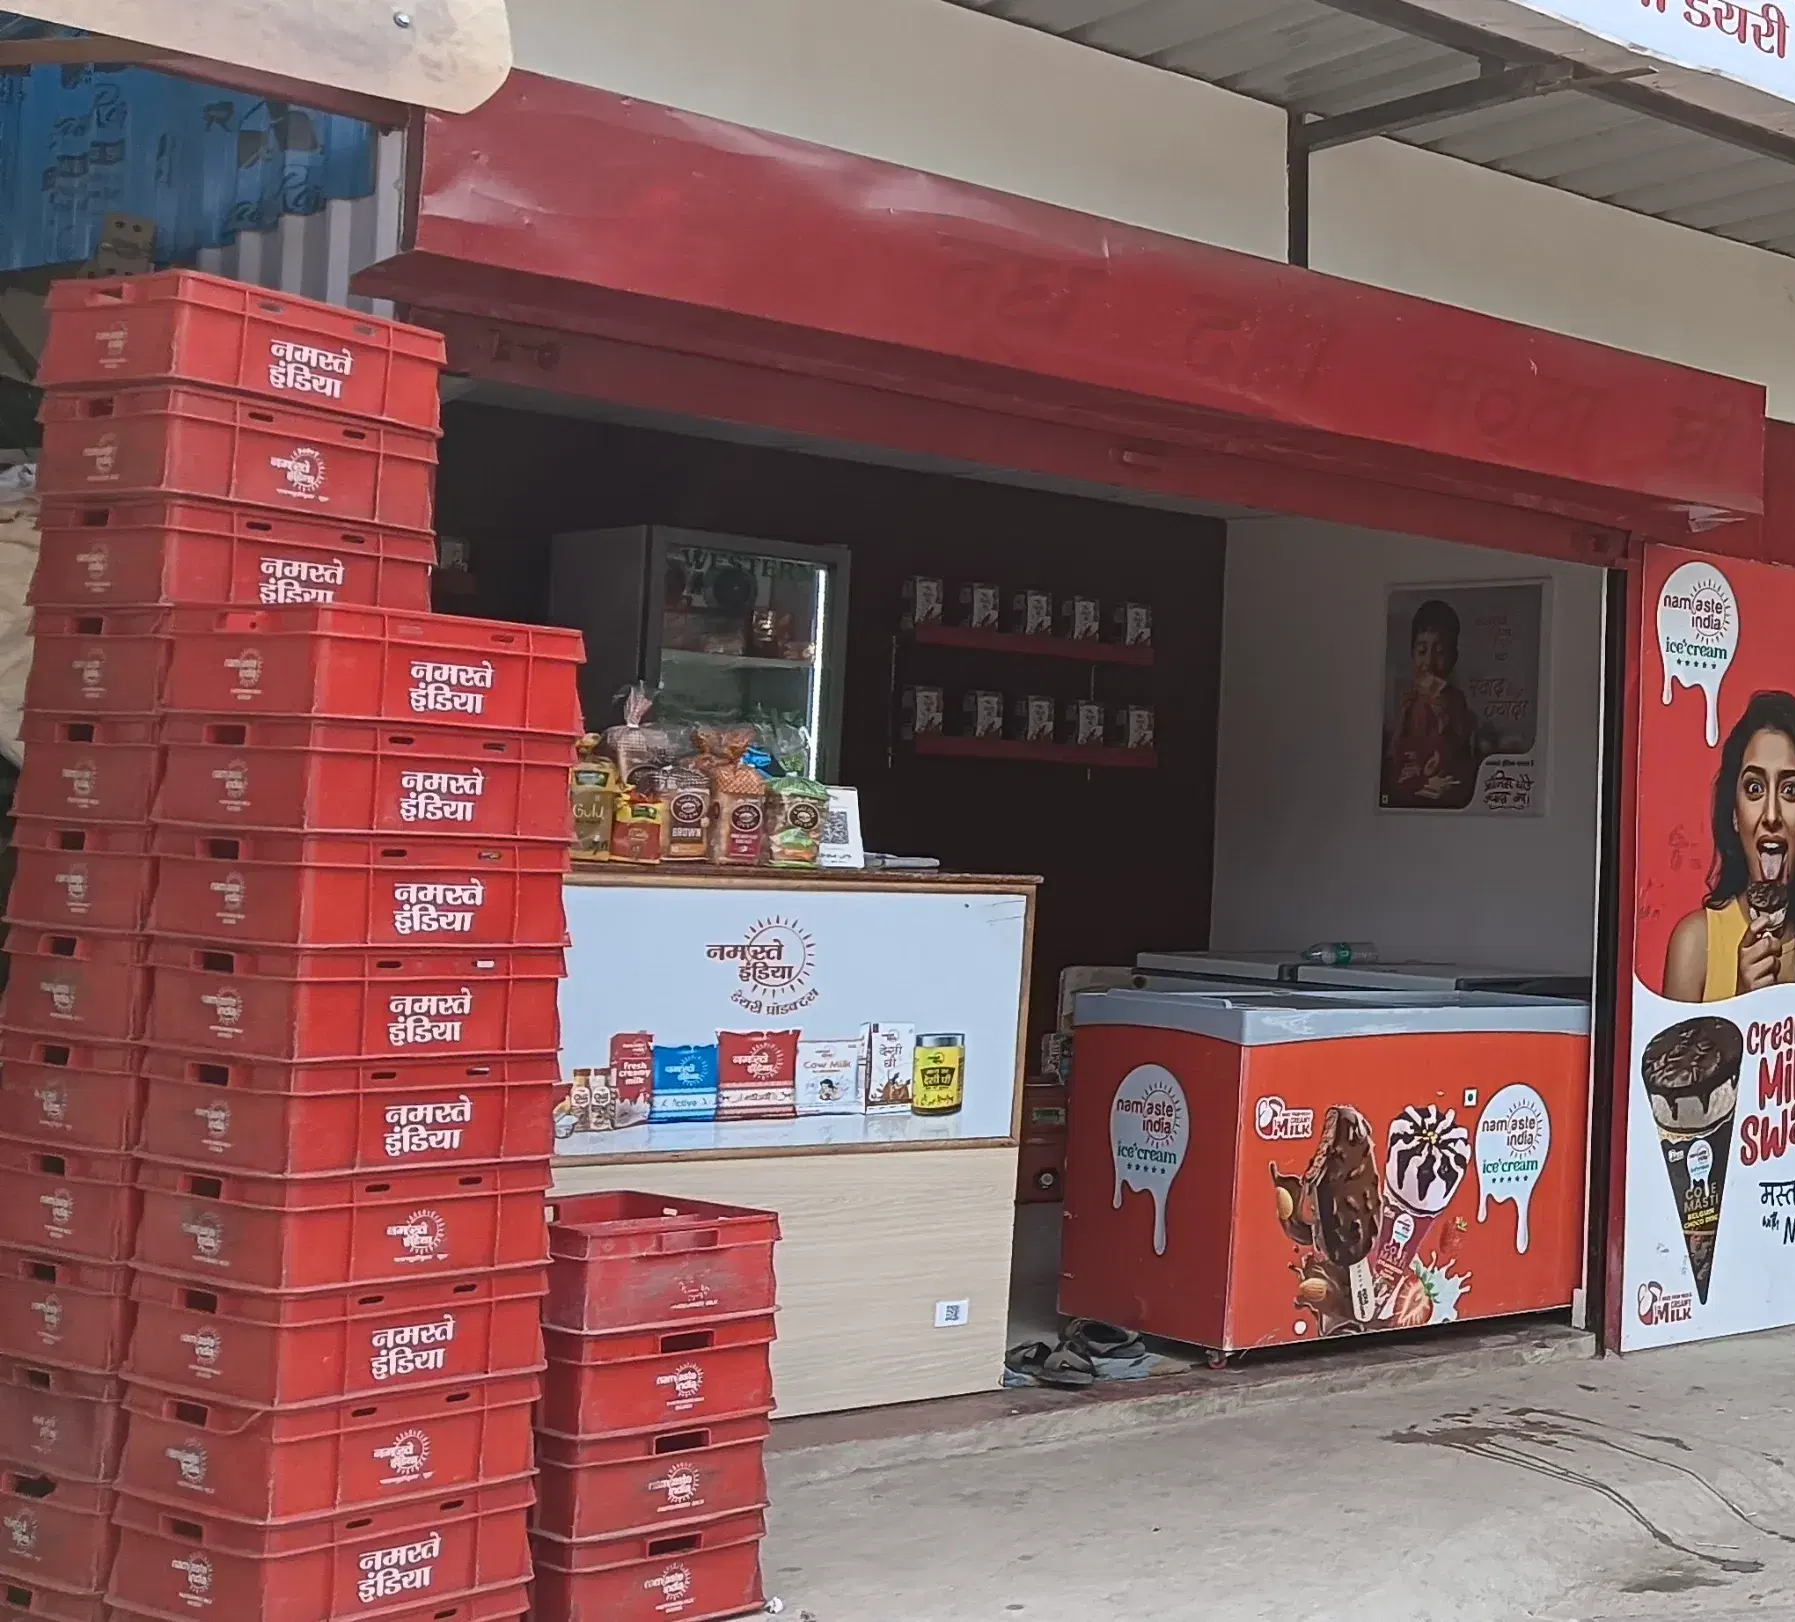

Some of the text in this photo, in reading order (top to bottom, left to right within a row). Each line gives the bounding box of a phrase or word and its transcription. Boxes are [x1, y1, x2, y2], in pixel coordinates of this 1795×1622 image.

[270, 339, 355, 375] नमस्ते
[268, 360, 343, 398] इंडिया
[260, 556, 344, 585] नमस्ते
[259, 577, 334, 604] इंडिया
[1664, 592, 1723, 614] namaste
[1691, 614, 1722, 631] india
[411, 660, 494, 688] नमस्ते
[409, 682, 484, 714] इंडिया
[402, 767, 484, 796] नमस्ते
[400, 791, 474, 821] इंडिया
[394, 878, 484, 907] नमस्ते
[393, 900, 474, 935] इंडिया
[705, 938, 784, 961] नमस्ते
[739, 961, 794, 982] इंडिया
[389, 986, 473, 1016] नमस्ते
[388, 1010, 462, 1046] इंडिया
[803, 1059, 852, 1069] Cow Milk
[385, 1094, 473, 1125] नमस्ते
[1117, 1099, 1173, 1117] namaste
[1143, 1117, 1171, 1134] india
[1274, 1118, 1310, 1136] MILK
[1482, 1116, 1536, 1132] namaste
[1506, 1130, 1534, 1146] india
[384, 1121, 463, 1157] इंडिया
[1684, 1194, 1719, 1213] MASTI
[1686, 1182, 1717, 1200] COE
[1654, 1302, 1691, 1325] MILK
[372, 1314, 456, 1348] नमस्ते
[370, 1345, 446, 1380] इंडिया
[359, 1531, 442, 1572] नमस्ते
[357, 1565, 432, 1603] इंडिया
